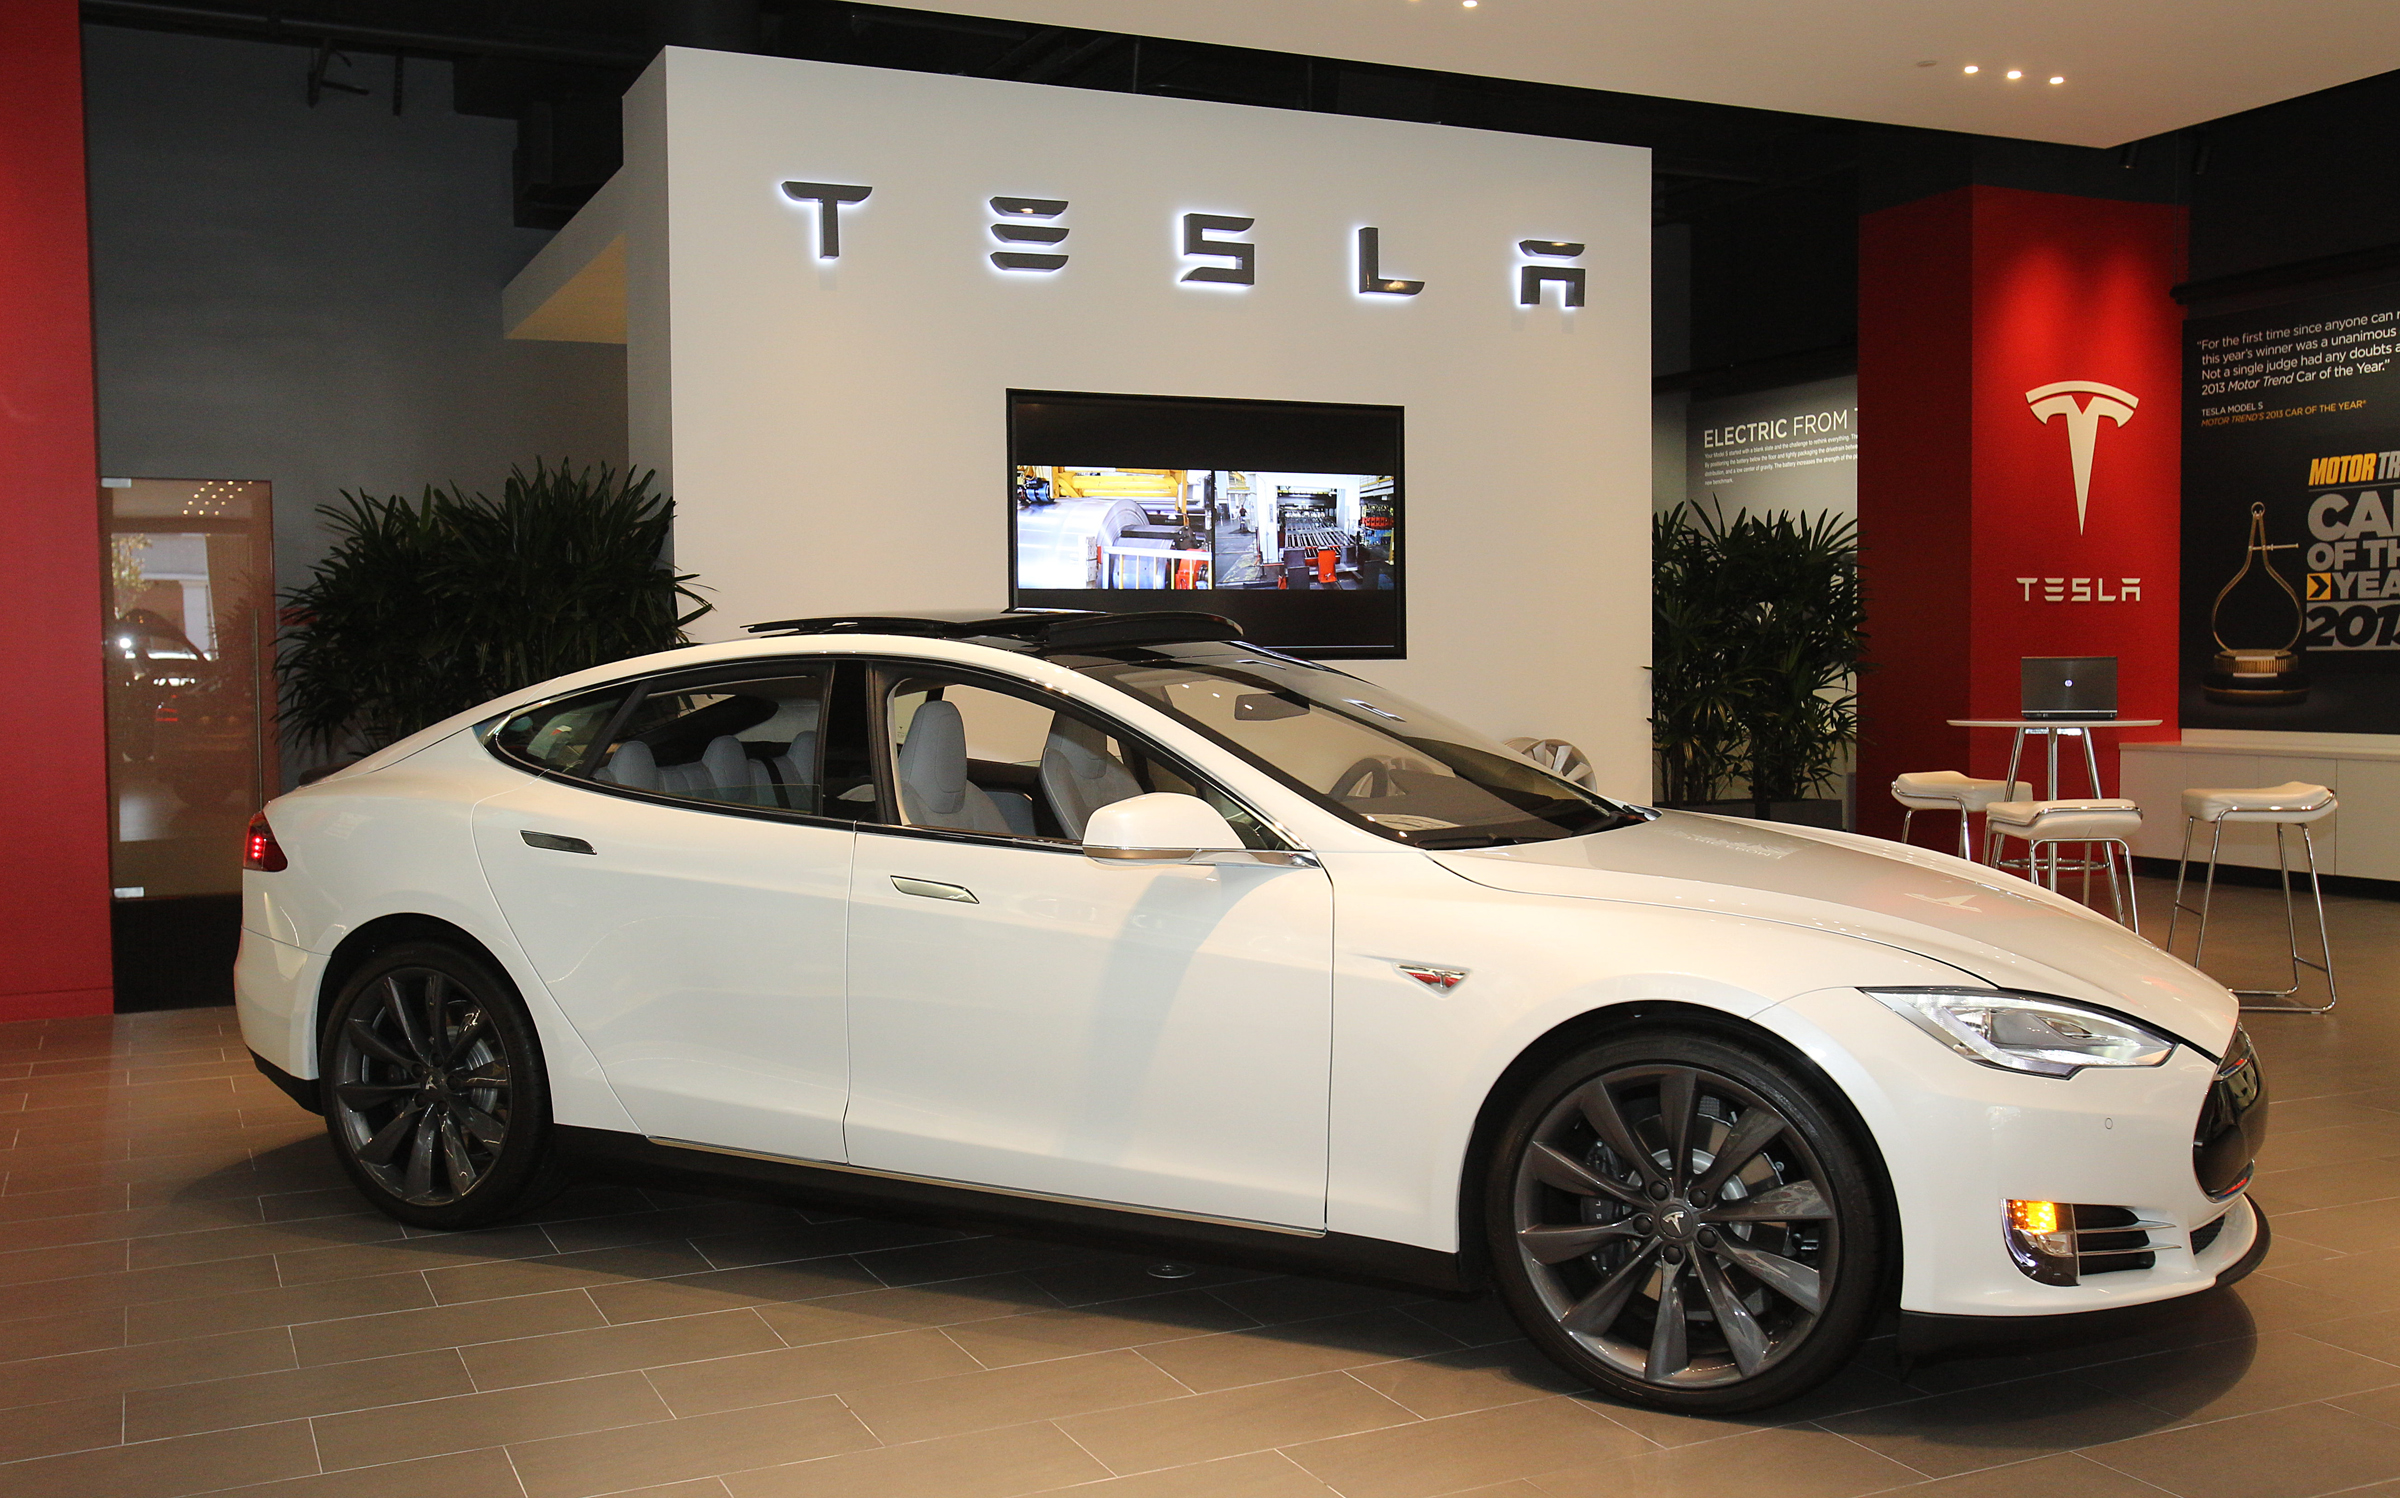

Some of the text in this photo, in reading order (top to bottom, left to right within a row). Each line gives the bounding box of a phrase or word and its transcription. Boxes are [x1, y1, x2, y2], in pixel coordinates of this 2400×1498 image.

[780, 179, 1586, 307] TESLA
[2202, 326, 2397, 366] this year's winner was a unanimous
[2222, 336, 2240, 348] the
[2242, 331, 2263, 344] first
[2266, 327, 2291, 341] time
[2293, 322, 2322, 336] since
[2325, 316, 2368, 332] anyone
[2371, 311, 2394, 324] can
[2201, 368, 2222, 381] Not
[2224, 368, 2230, 378] a
[2232, 362, 2264, 378] single
[2265, 356, 2298, 374] judge
[2300, 352, 2322, 366] had
[2325, 350, 2347, 366] any
[2349, 344, 2392, 360] doubts
[2201, 382, 2226, 396] 2013
[2227, 379, 2260, 393] Motor
[2262, 373, 2294, 387] Trend
[2296, 370, 2316, 383] Car
[2319, 368, 2332, 380] of
[2334, 364, 2354, 378] the
[2201, 401, 2264, 416] TESLA MODEL S
[2201, 416, 2230, 427] MOTOR
[2231, 412, 2265, 423] TREND'S
[2266, 410, 2284, 420] 2013
[2285, 407, 2304, 417] CAR
[2304, 405, 2318, 414] OF
[2319, 402, 2336, 412] THE
[1704, 409, 1848, 448] ELECTRIC FROM
[2308, 450, 2400, 486] MOTOR TR
[2308, 489, 2400, 542] CA
[2307, 542, 2357, 572] OF
[2016, 578, 2141, 602] TESLA
[2332, 569, 2400, 600] YEA
[2306, 604, 2400, 648] 201
